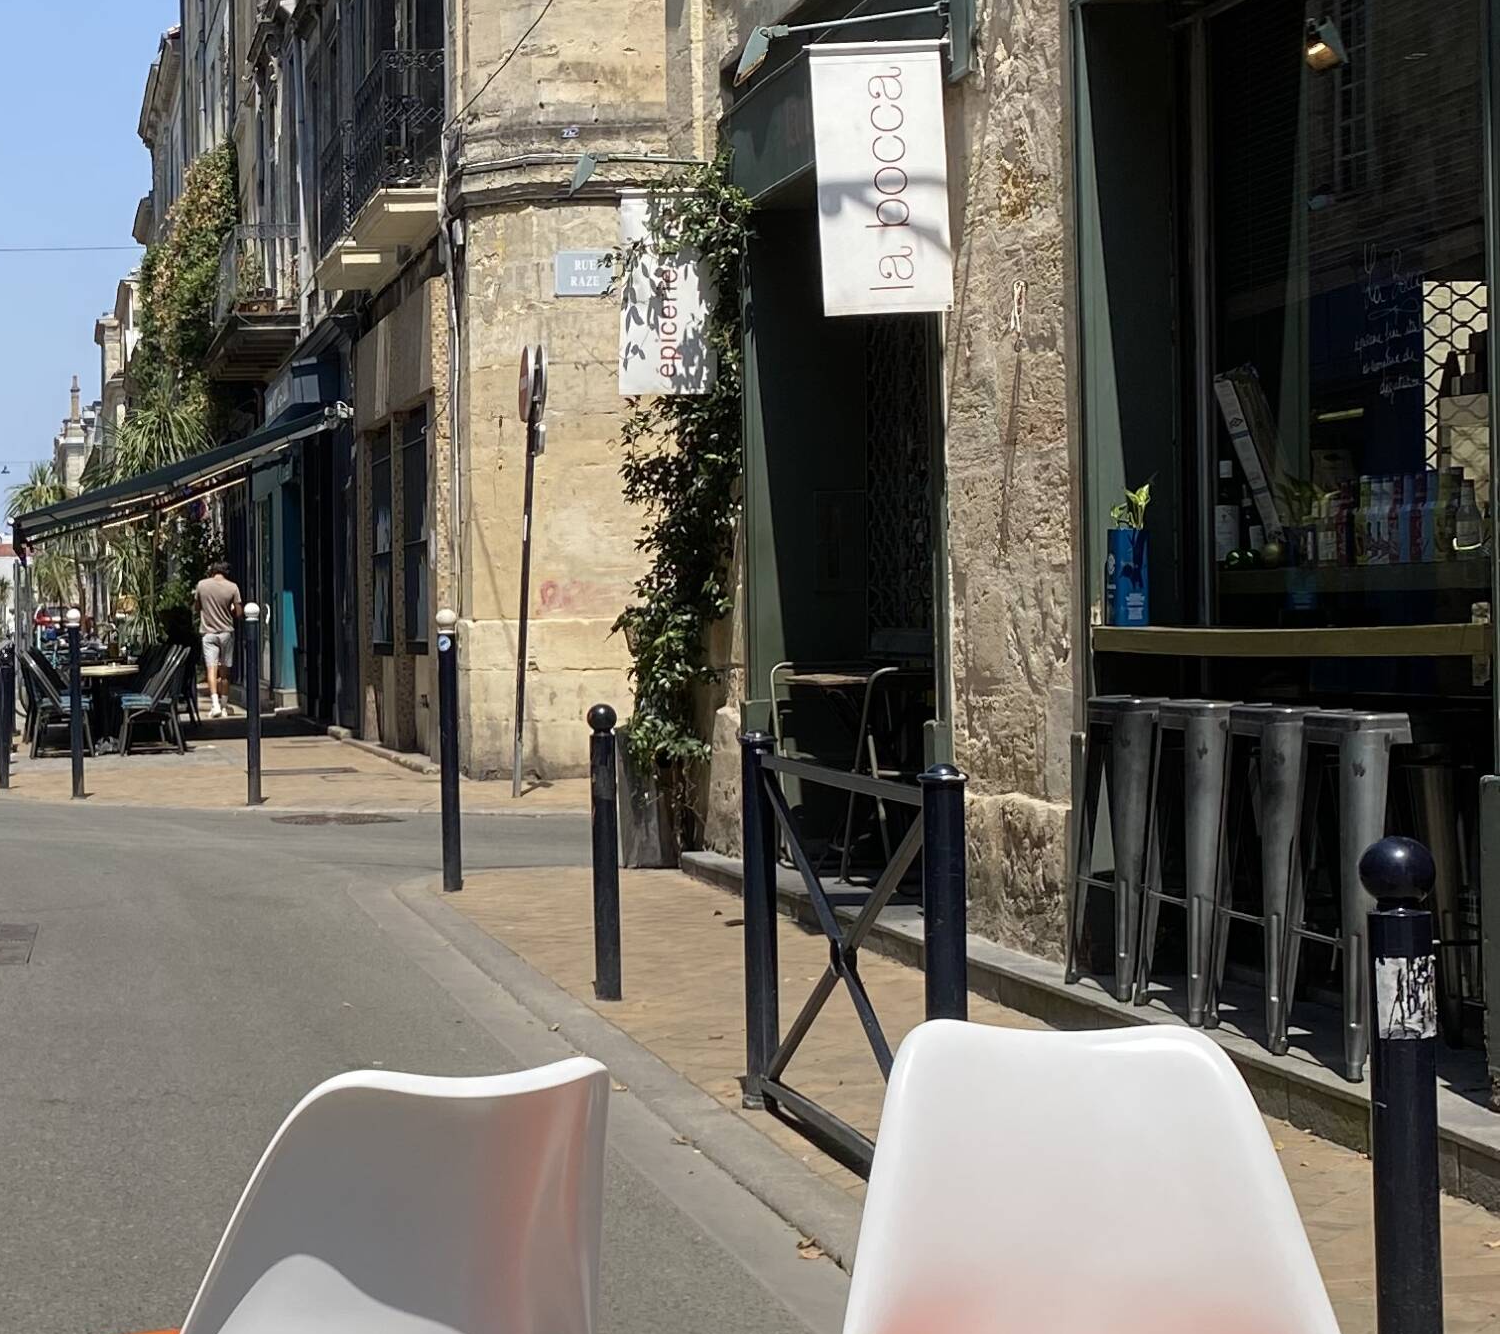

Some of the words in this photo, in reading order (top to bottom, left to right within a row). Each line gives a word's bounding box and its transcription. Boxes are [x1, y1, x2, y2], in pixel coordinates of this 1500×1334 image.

[865, 66, 911, 229] bocca
[574, 259, 597, 271] RUE
[868, 245, 915, 291] la
[570, 275, 600, 287] RAZE
